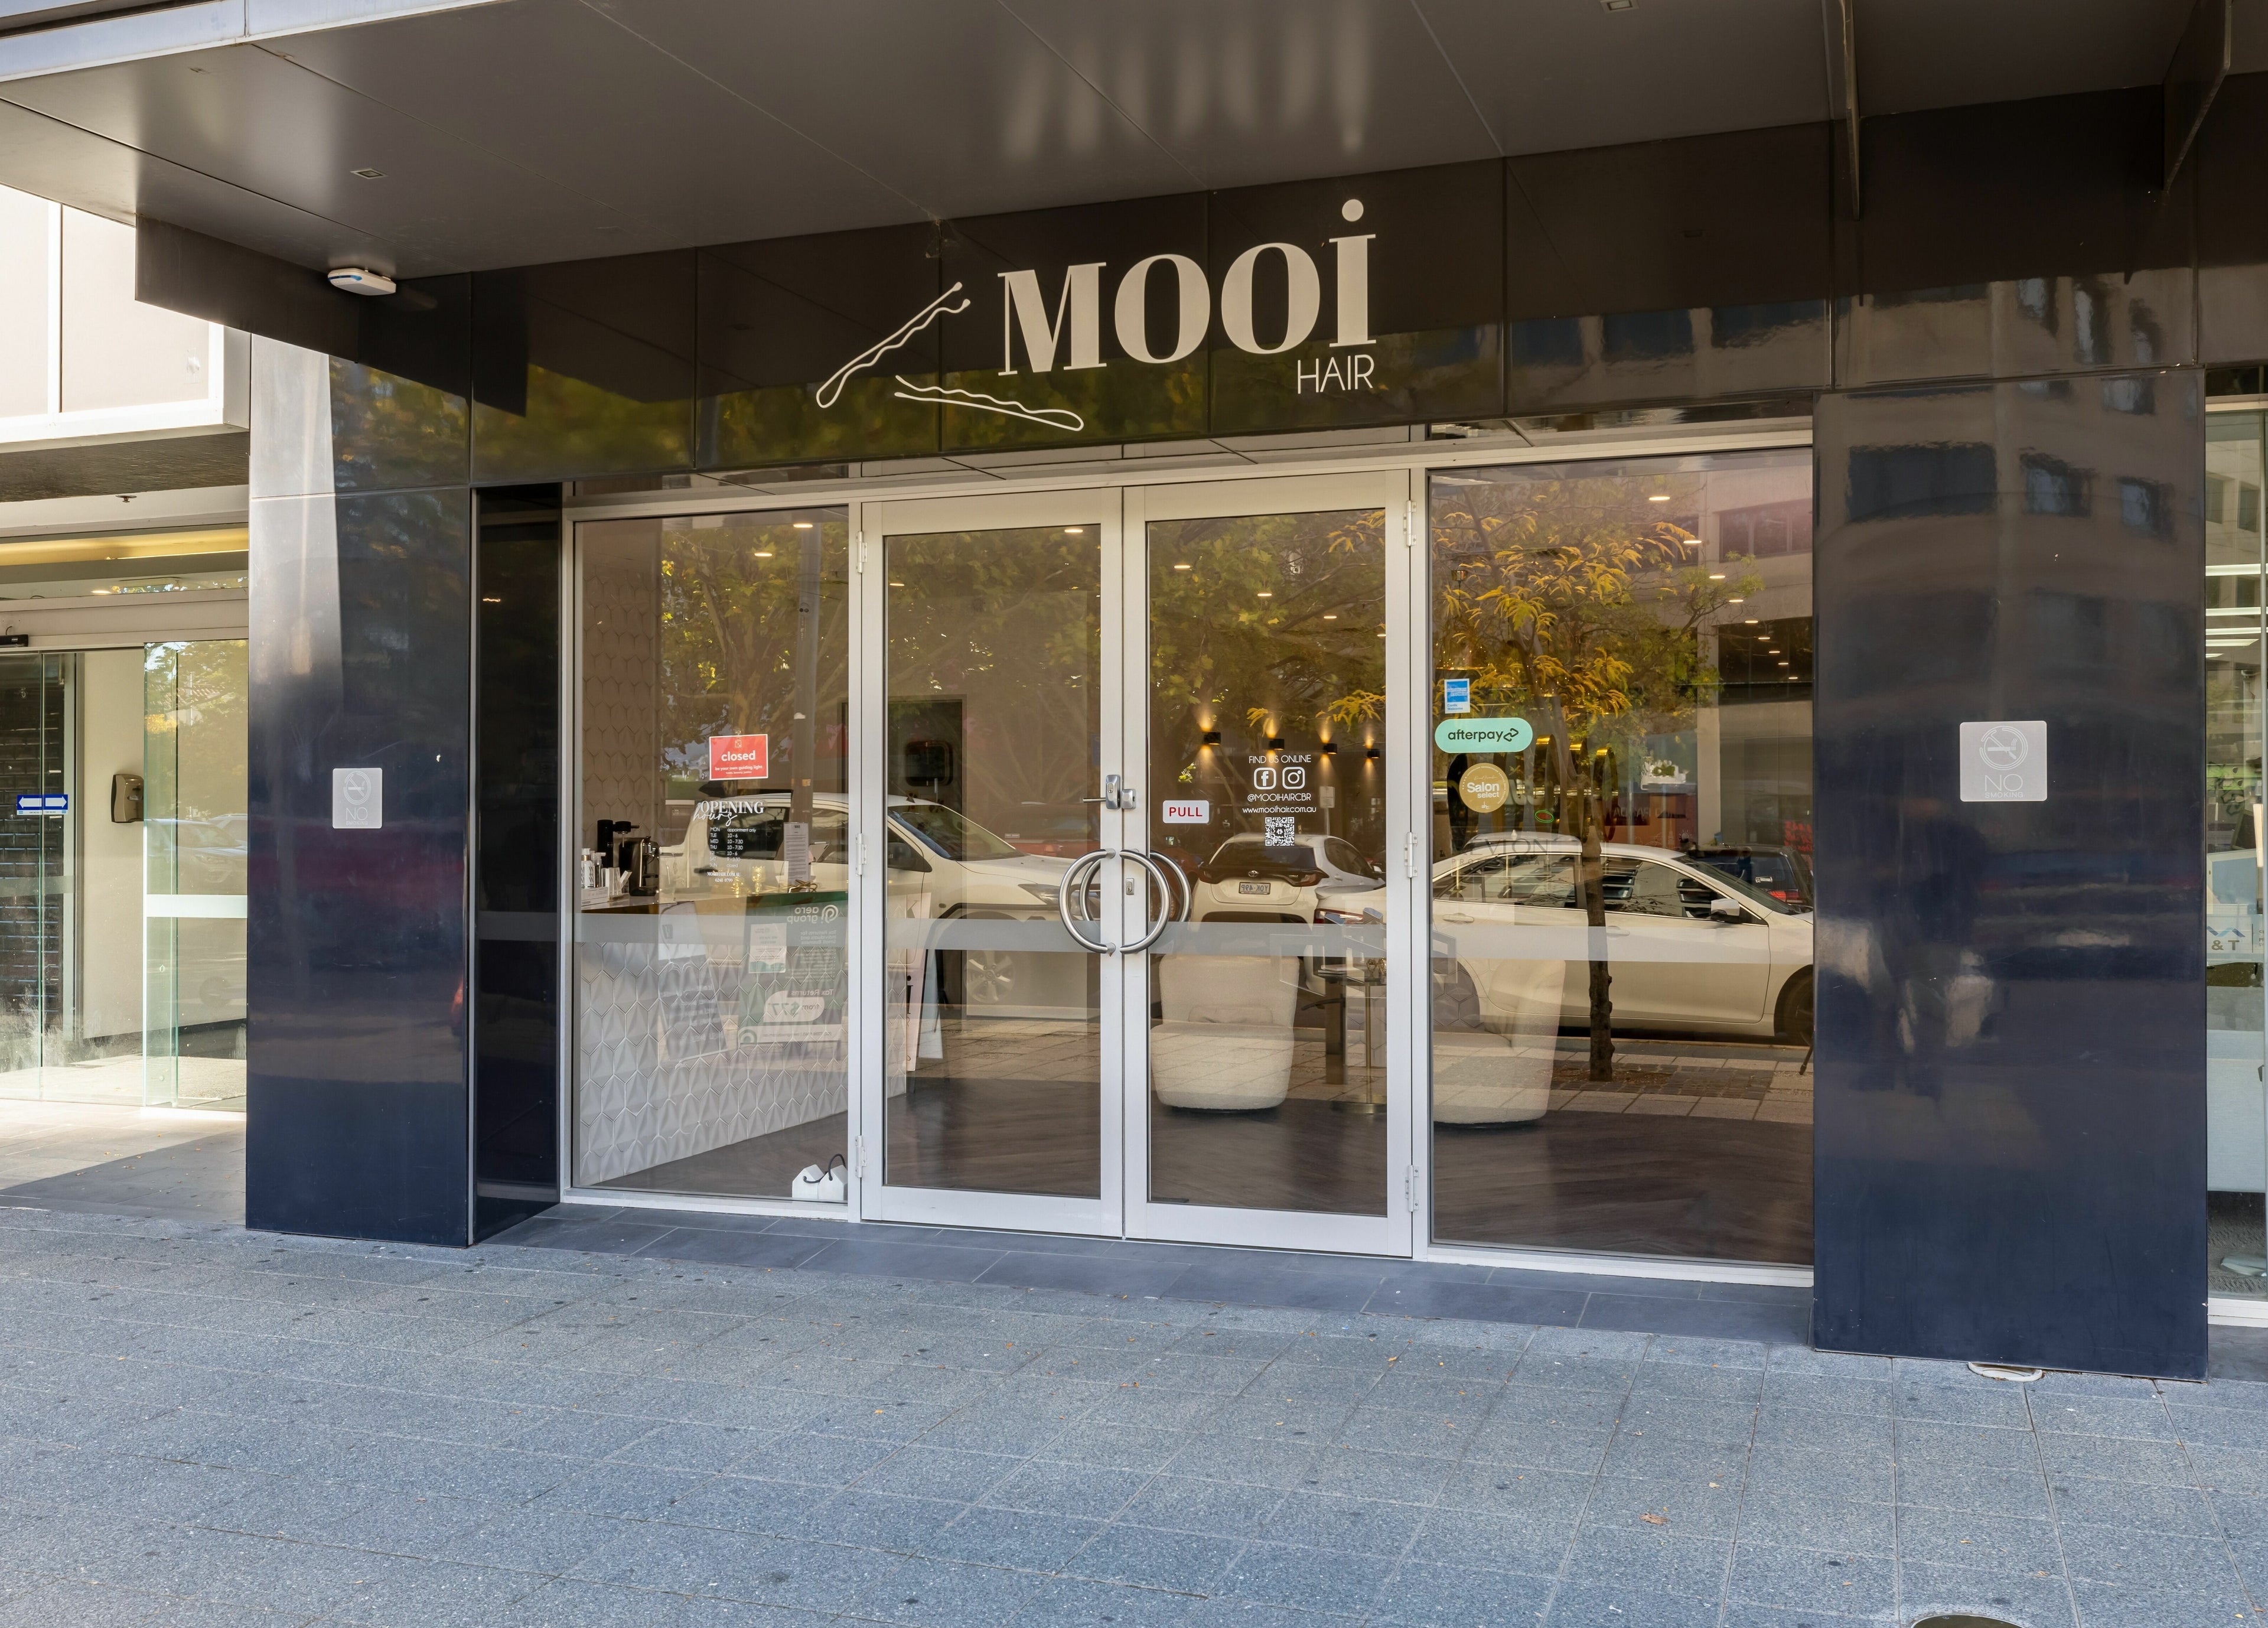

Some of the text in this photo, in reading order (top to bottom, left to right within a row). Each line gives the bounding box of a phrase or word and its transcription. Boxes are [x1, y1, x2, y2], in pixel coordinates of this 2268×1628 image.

[1297, 354, 1375, 394] HAIR
[1448, 729, 1504, 742] afterpay
[721, 750, 755, 761] closed
[1249, 754, 1312, 764] FIND US ONLINE
[1467, 782, 1500, 793] Salon
[1984, 774, 2023, 792] NO
[1247, 793, 1311, 802] @MOOIHAIRCBR
[700, 800, 764, 814] OPENING
[1169, 807, 1203, 817] PULL
[1242, 805, 1317, 813] www.mooihair.com.au
[346, 807, 368, 820] NO
[693, 802, 738, 827] hours
[2211, 940, 2240, 950] & T
